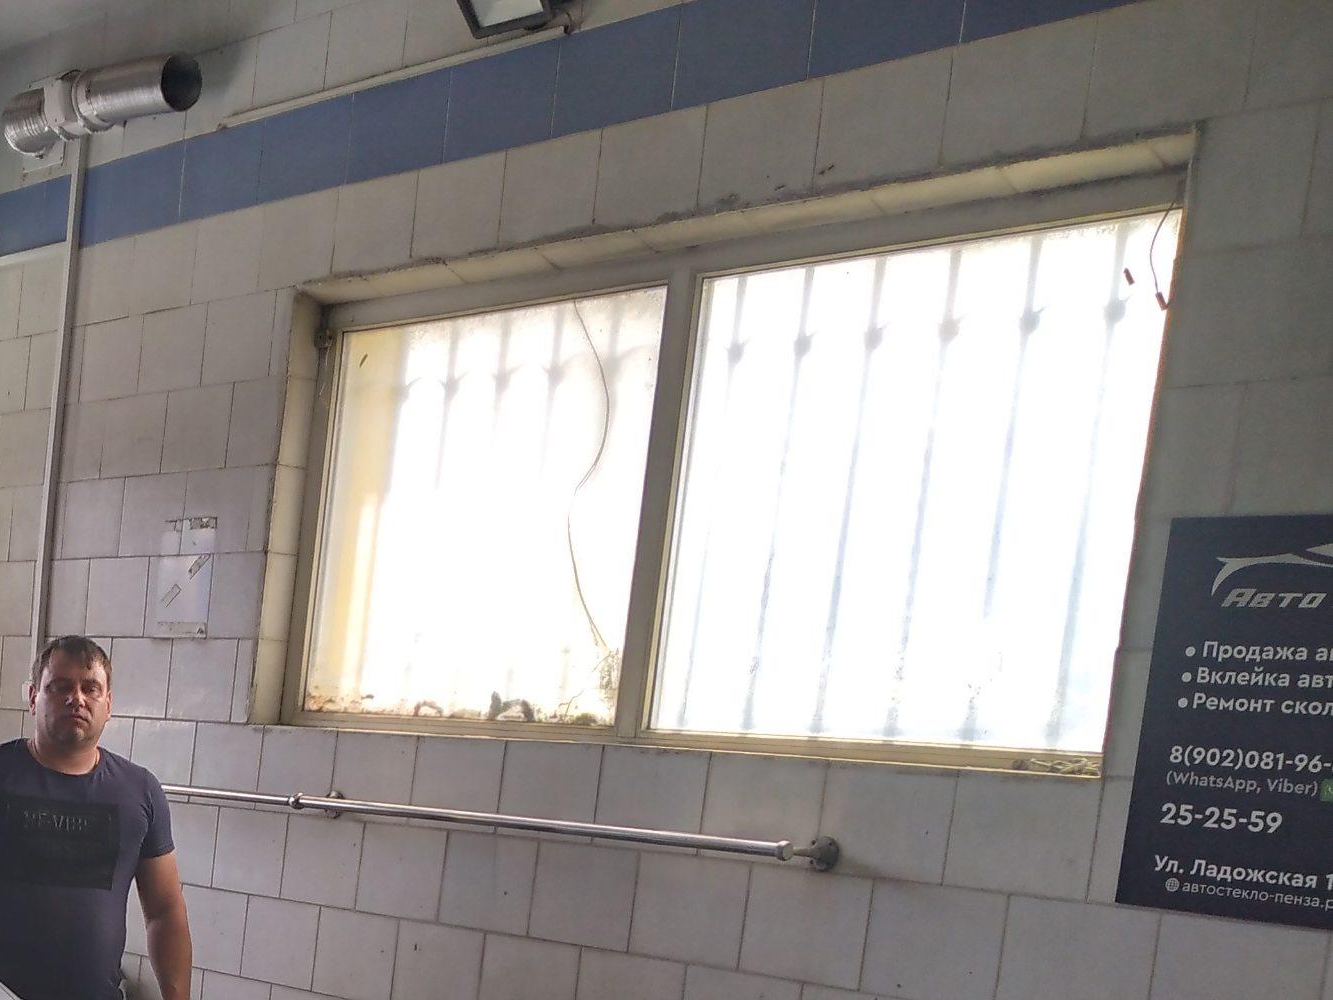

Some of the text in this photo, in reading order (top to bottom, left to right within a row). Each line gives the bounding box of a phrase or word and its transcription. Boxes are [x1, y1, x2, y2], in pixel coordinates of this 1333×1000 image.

[1202, 640, 1308, 662] Продажа
[1196, 666, 1290, 687] Вклейка
[1192, 692, 1275, 713] Ремонт
[1169, 745, 1333, 773] 8(902)081-96-
[1166, 770, 1318, 797] (WhatsApp, Viber)
[1160, 802, 1283, 834] 25-25-59
[1154, 855, 1184, 874] Ул.
[1190, 859, 1317, 889] Ладожская
